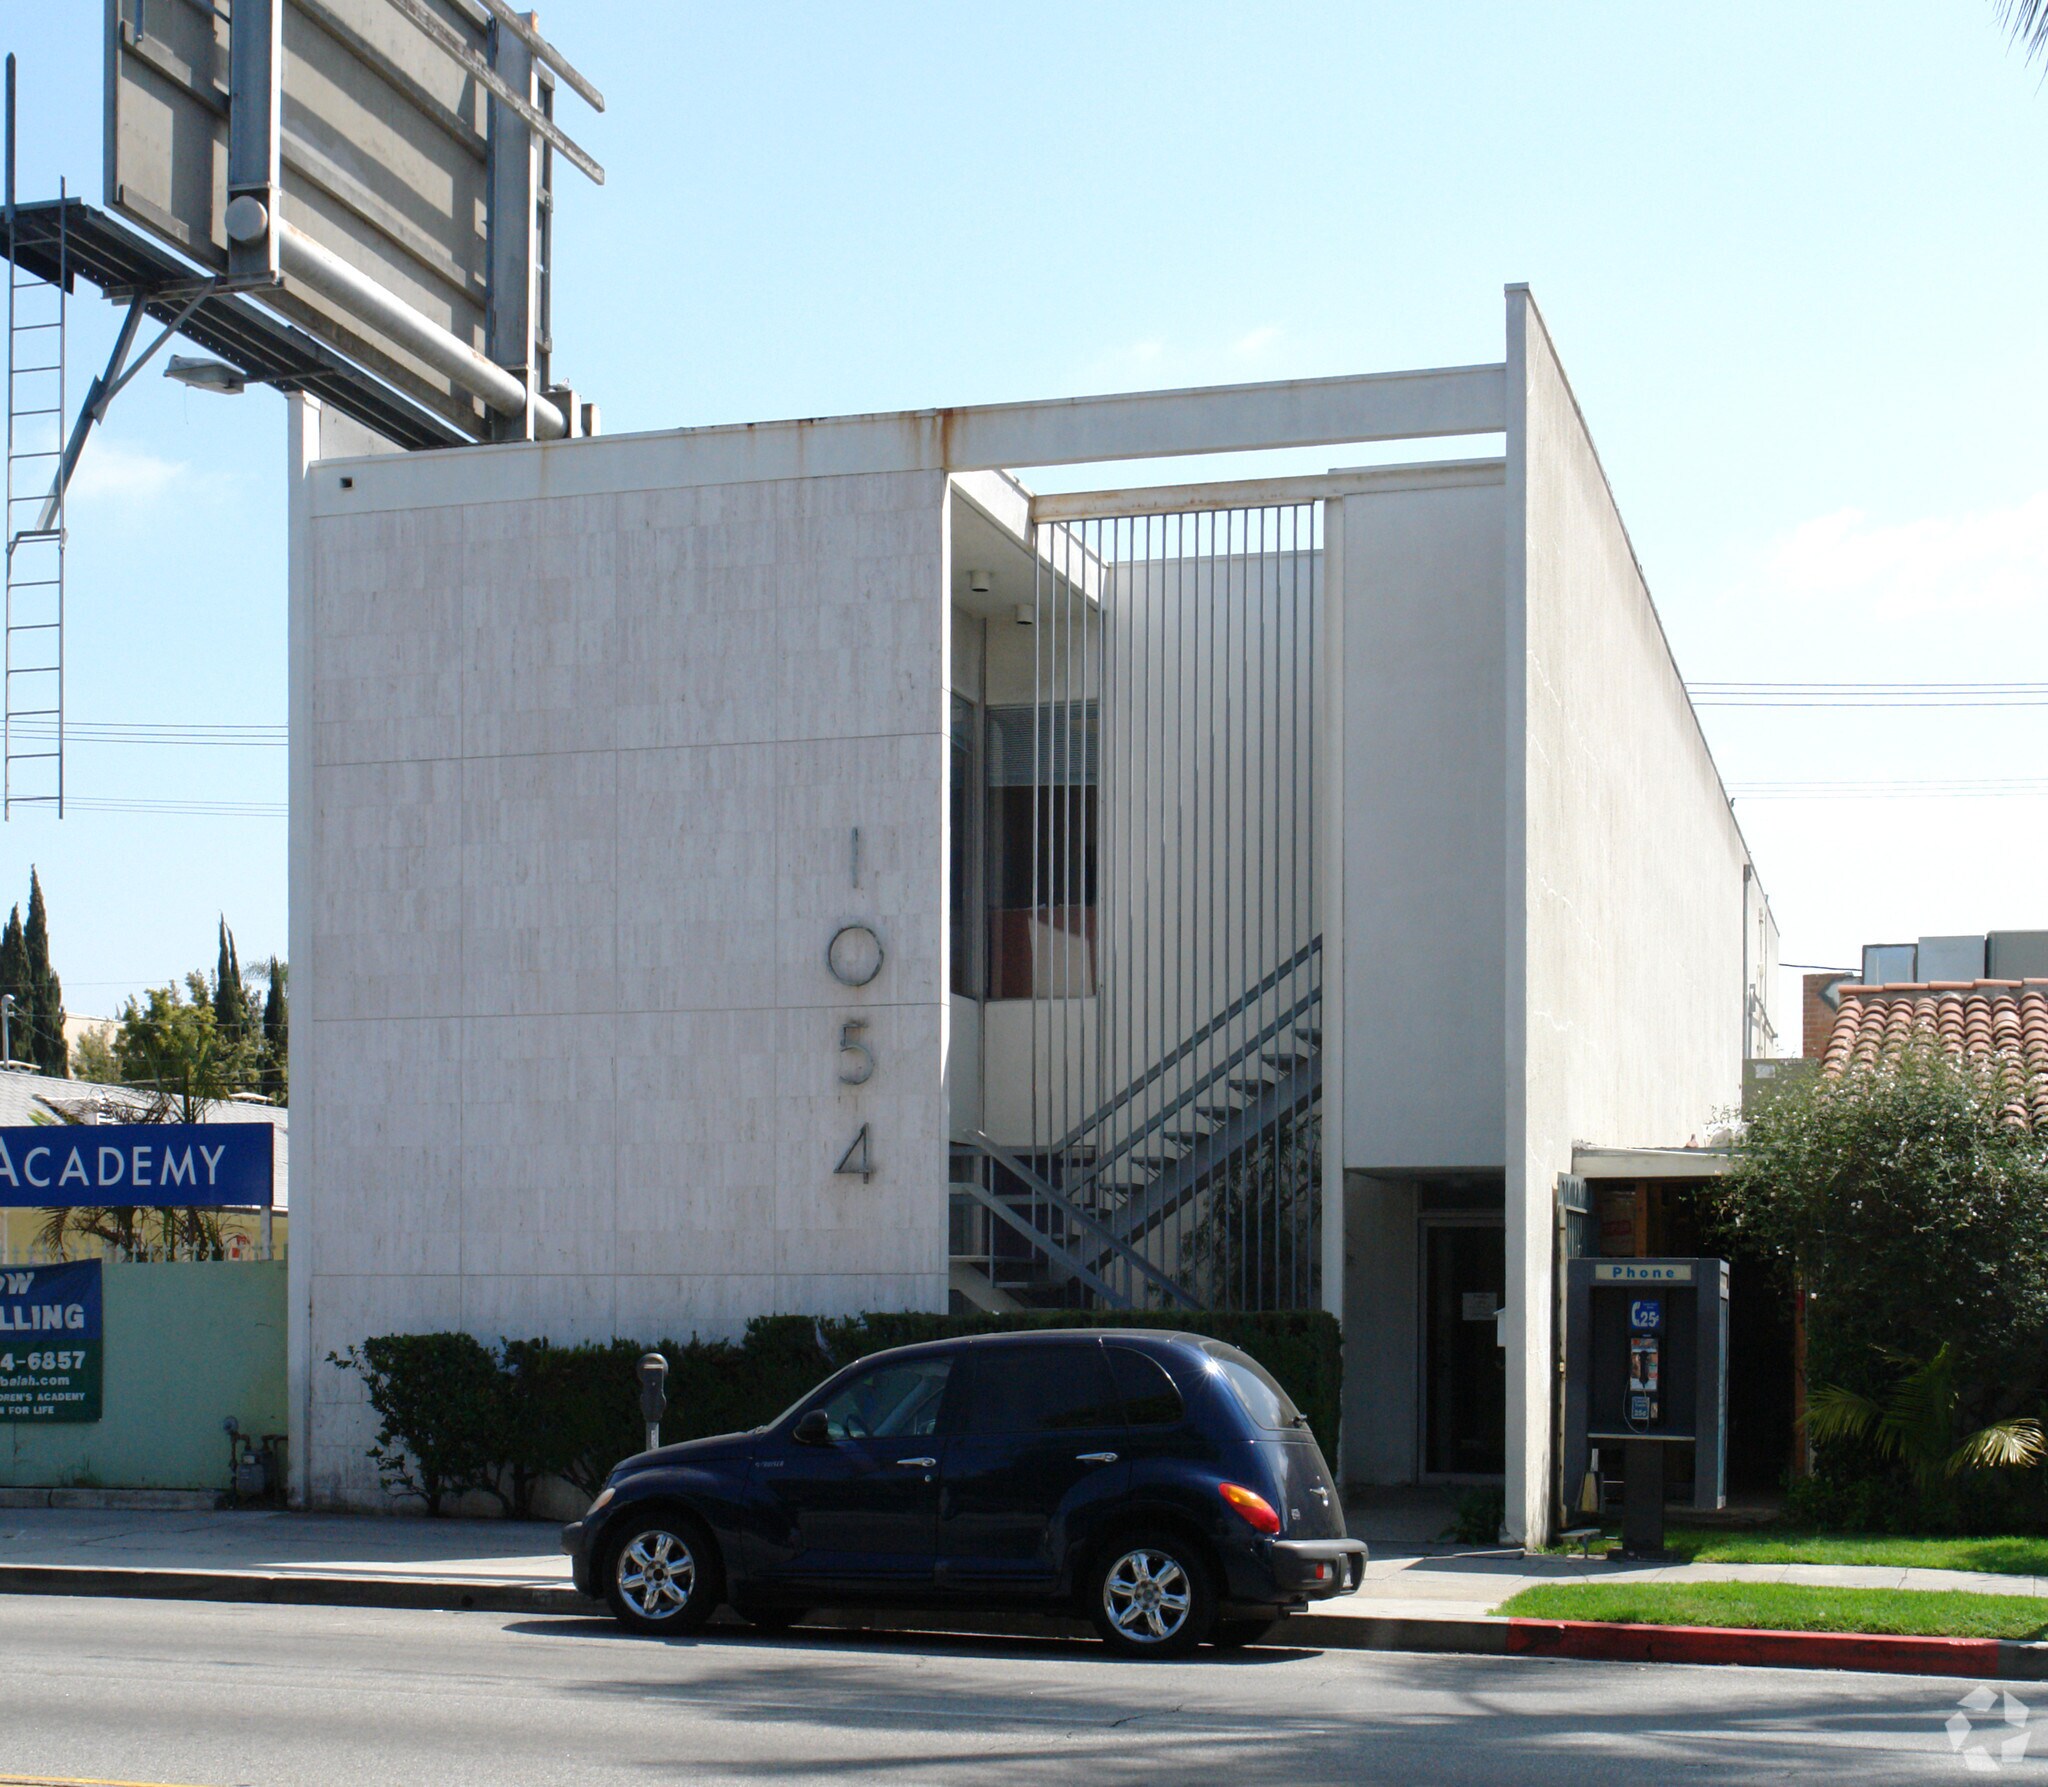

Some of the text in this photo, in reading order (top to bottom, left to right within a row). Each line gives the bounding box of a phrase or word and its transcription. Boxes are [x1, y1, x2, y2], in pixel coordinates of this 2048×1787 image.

[1612, 1266, 1675, 1279] Phone
[0, 1272, 35, 1295] W
[0, 1303, 85, 1331] LLING
[0, 1350, 86, 1371] 4-6857
[37, 1392, 86, 1401] ACADEMY
[8, 1406, 30, 1415] FOR
[33, 1405, 55, 1415] LIFE
